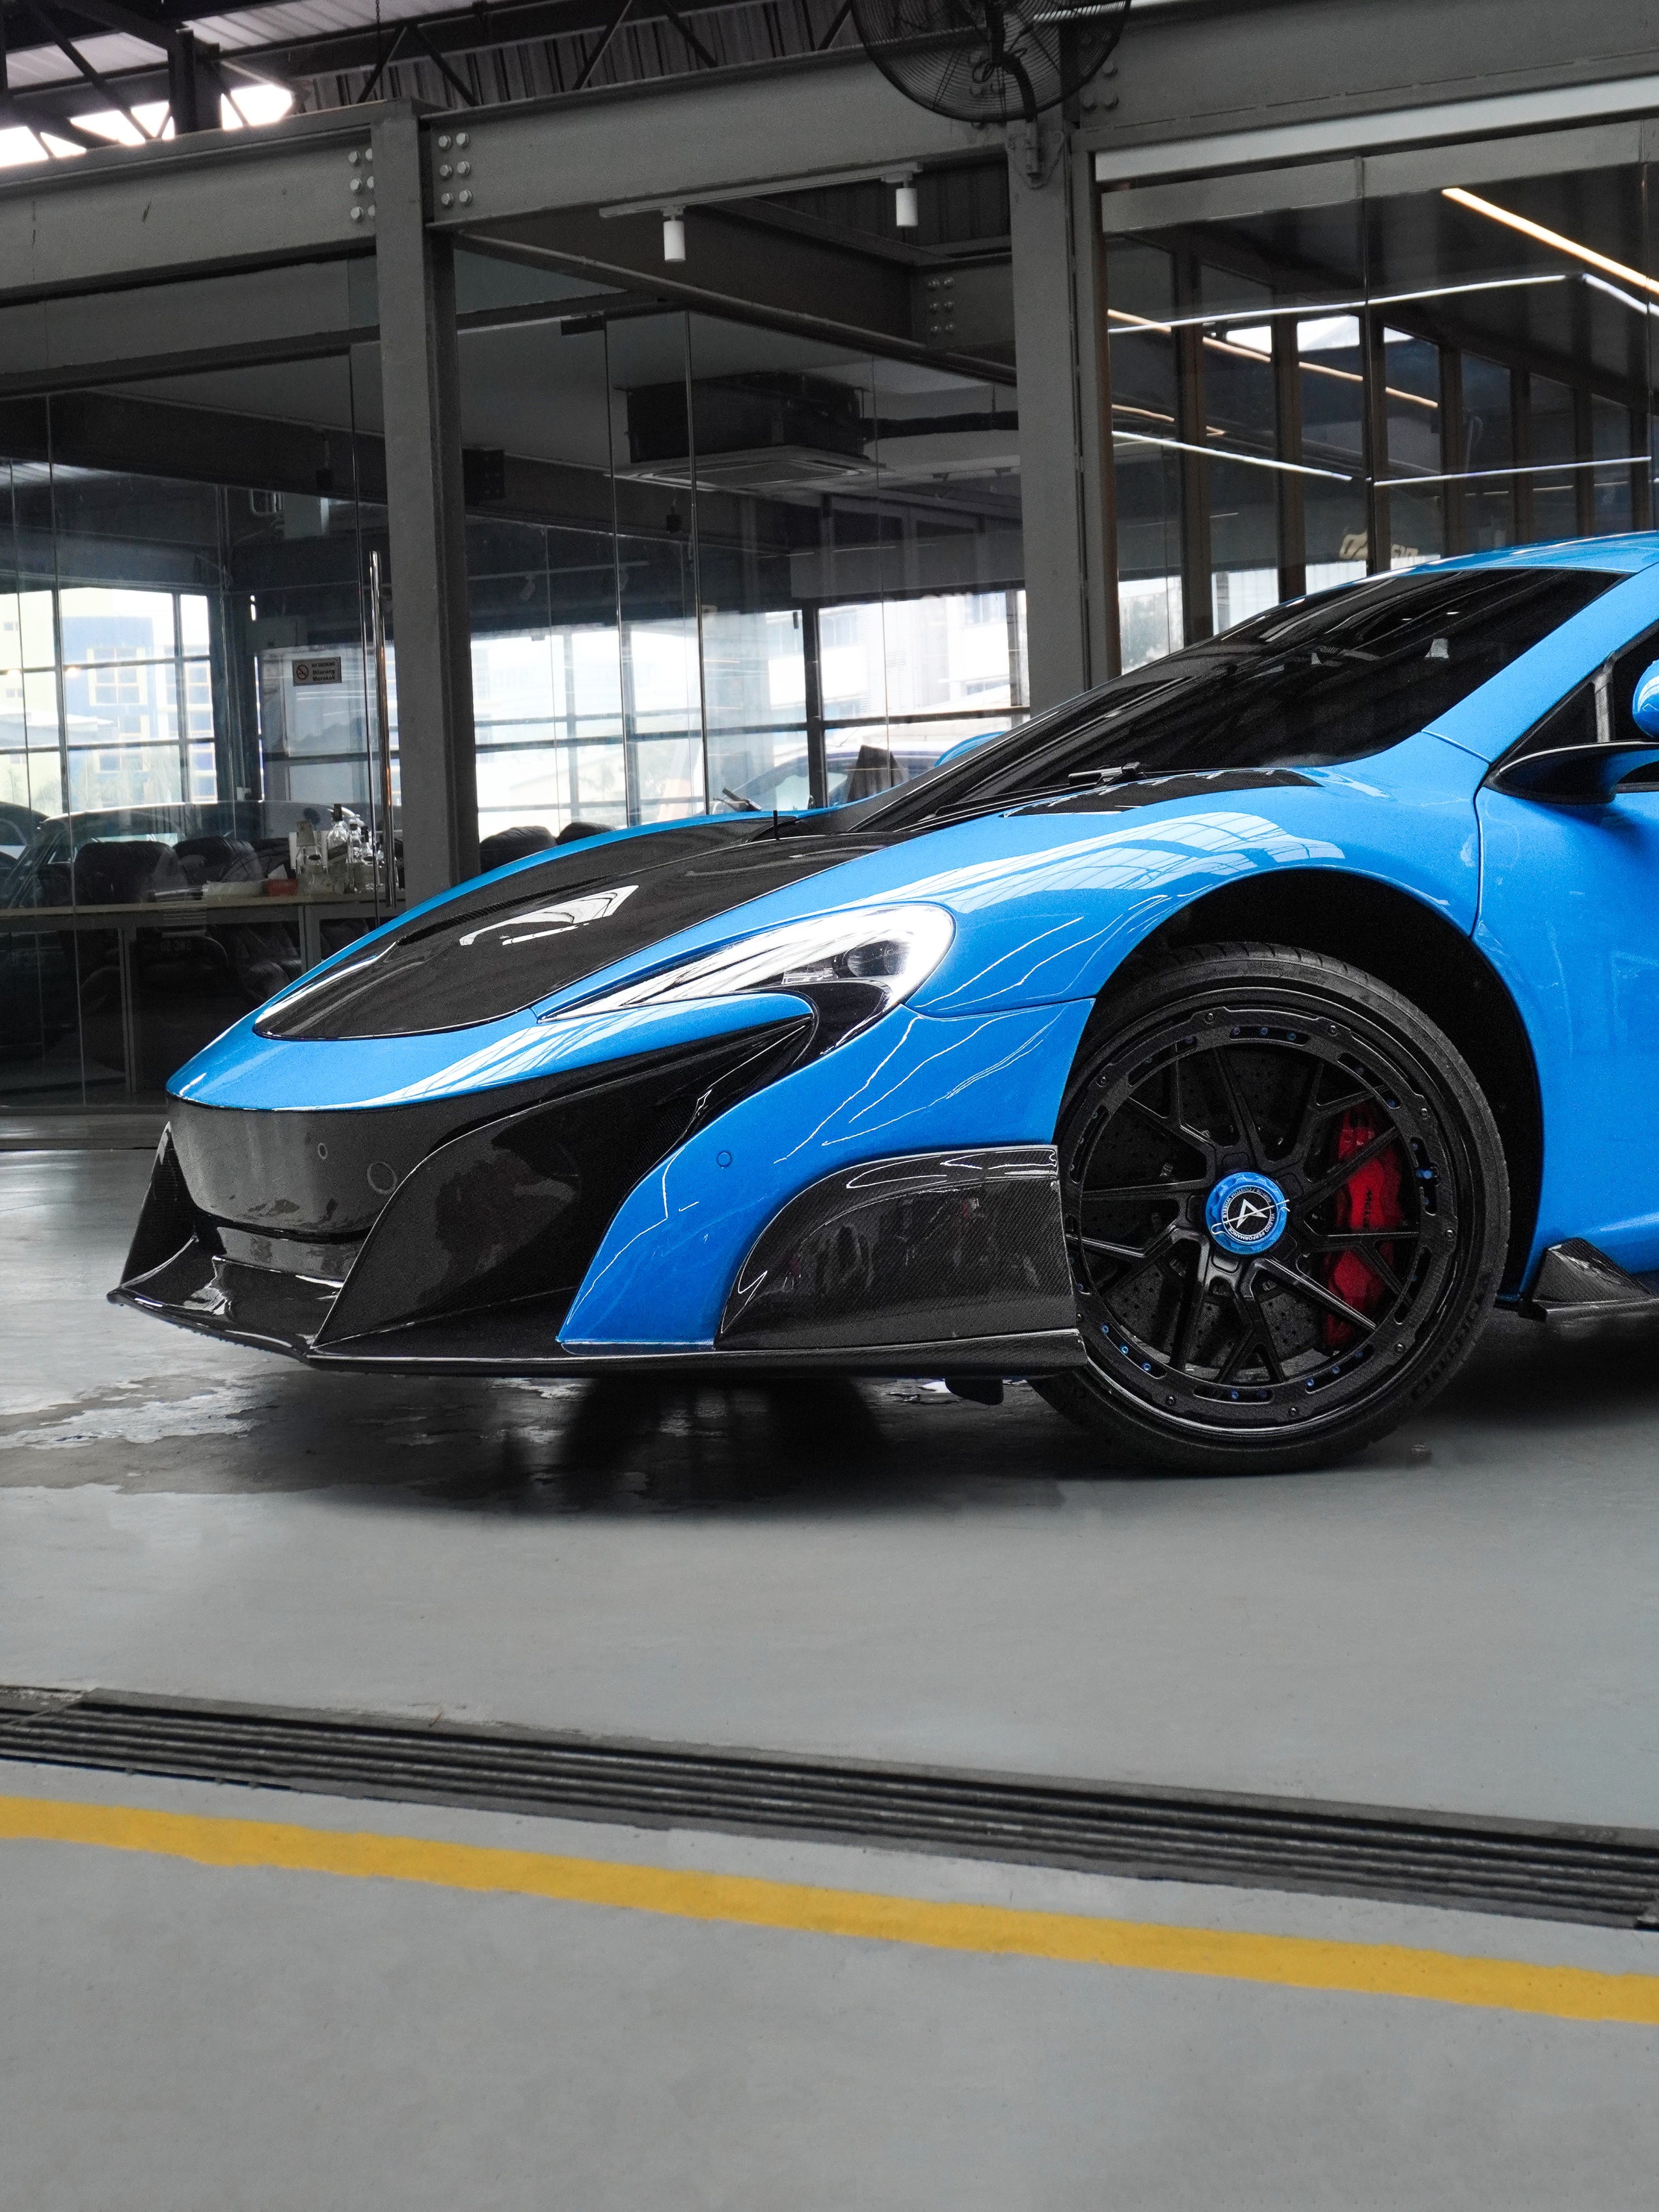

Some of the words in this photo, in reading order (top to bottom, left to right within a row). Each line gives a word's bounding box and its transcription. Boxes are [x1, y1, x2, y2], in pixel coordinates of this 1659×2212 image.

[1231, 1187, 1252, 1198] CUSTOM
[1222, 1197, 1232, 1218] WHEELS
[1265, 1213, 1275, 1233] VELENO
[1228, 1227, 1265, 1241] PERFORMANCE
